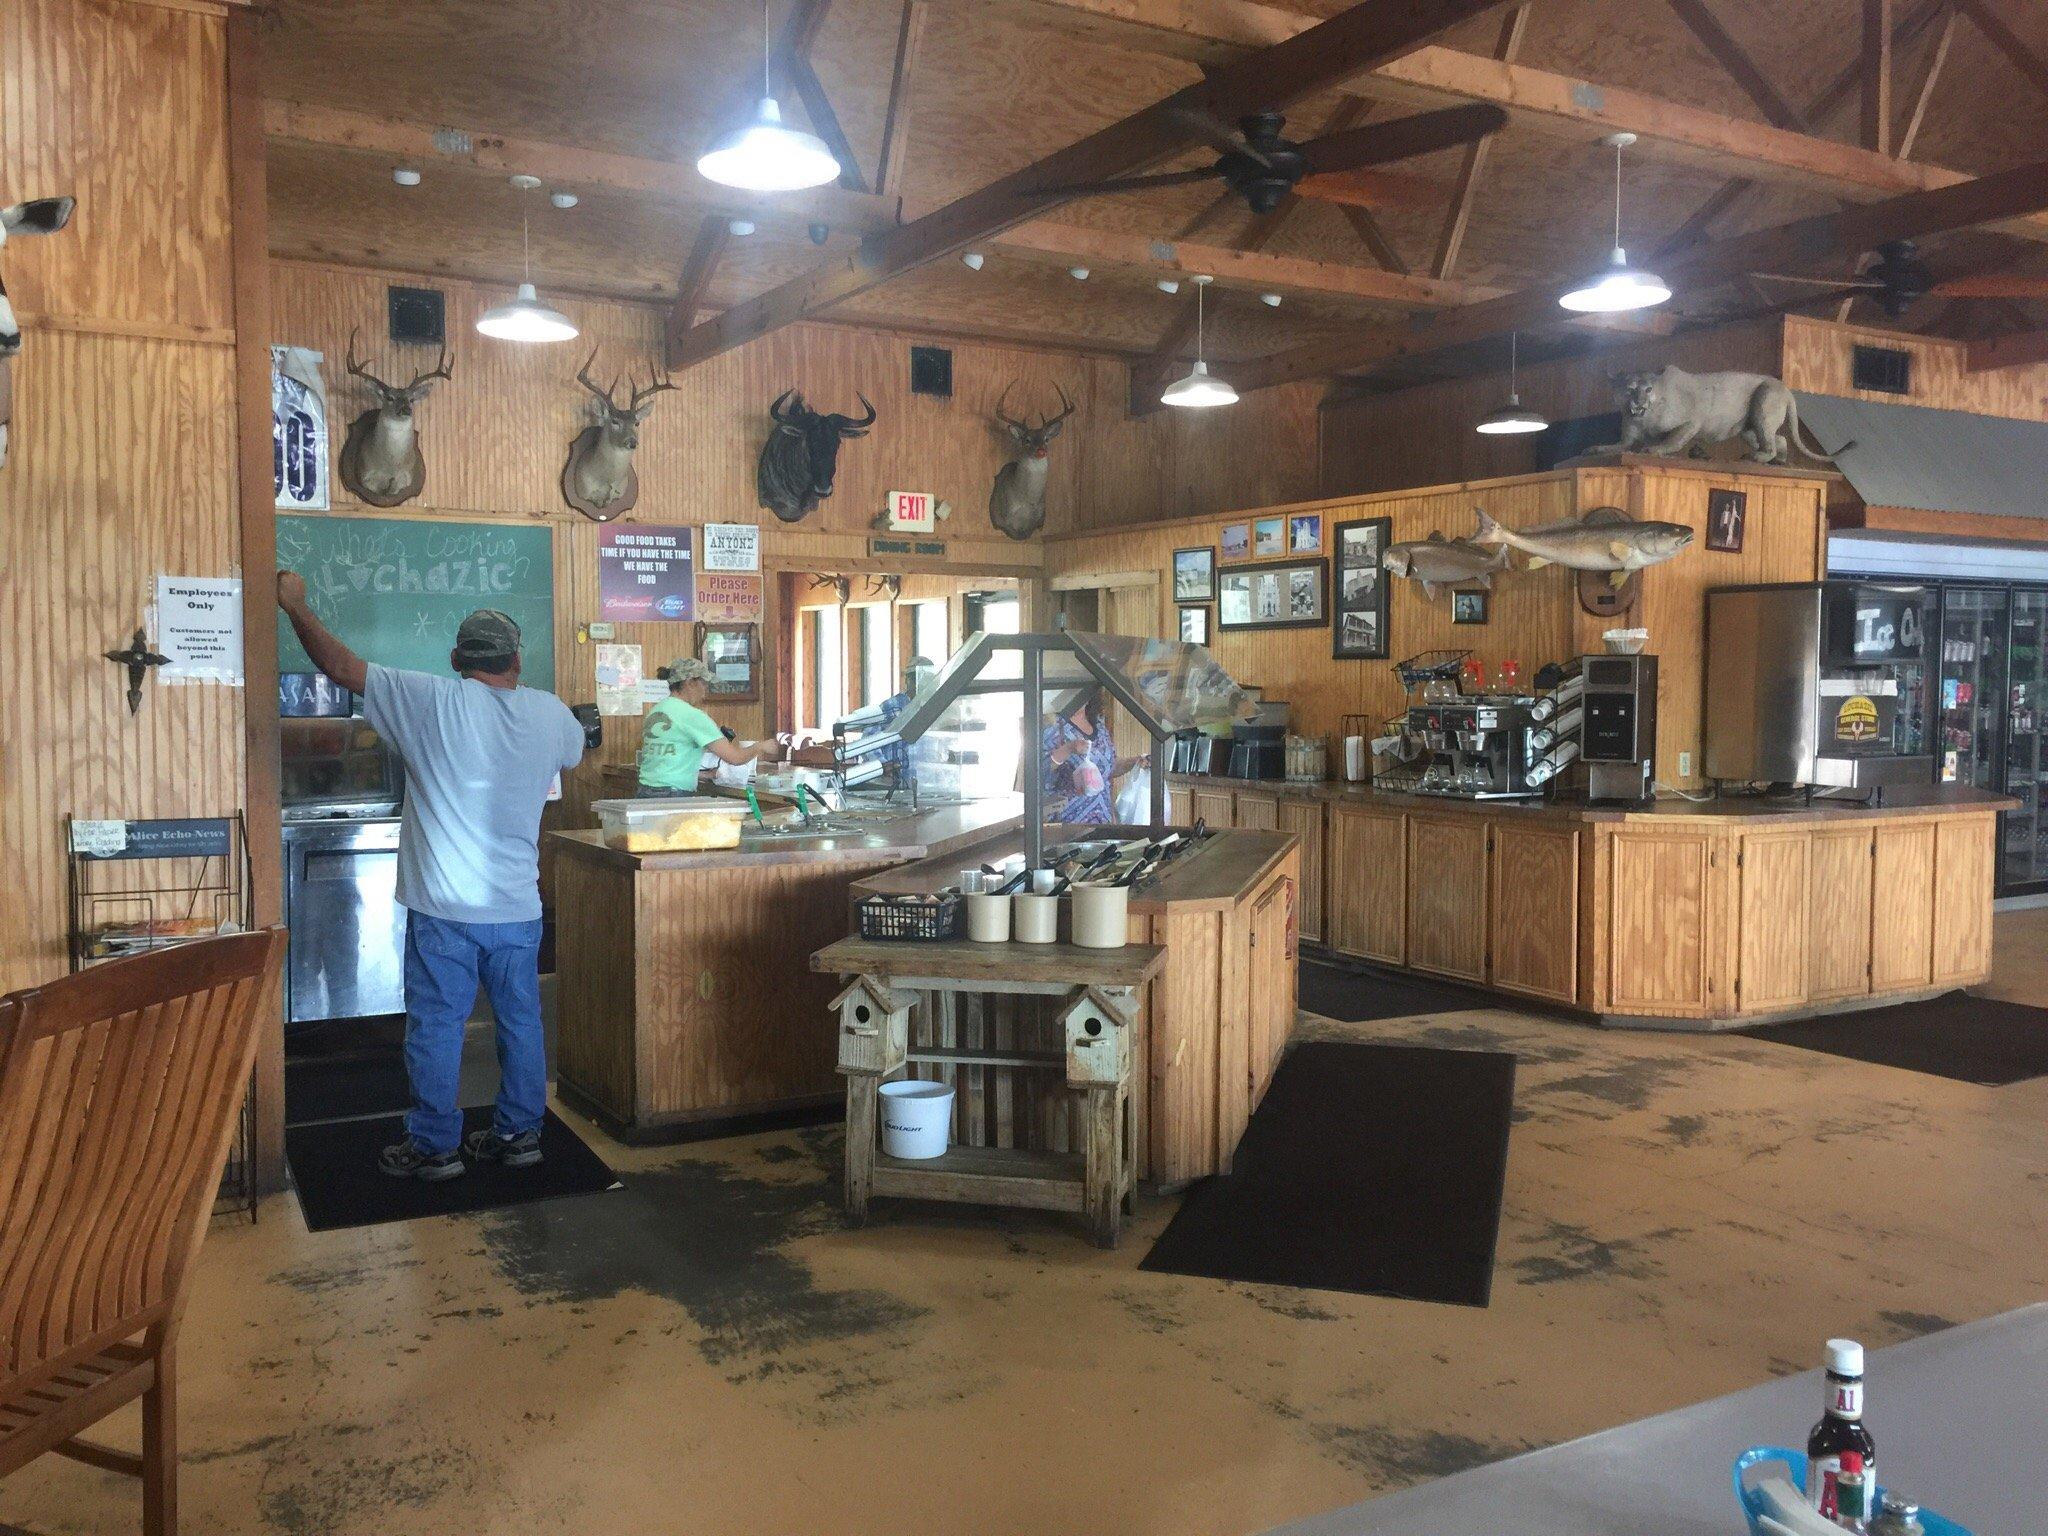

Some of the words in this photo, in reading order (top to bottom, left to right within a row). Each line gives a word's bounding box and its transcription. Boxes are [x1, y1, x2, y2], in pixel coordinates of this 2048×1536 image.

[899, 495, 927, 520] EXIT
[615, 535, 635, 545] GOOD
[636, 535, 654, 545] FOOD
[655, 536, 677, 547] TAKES
[601, 547, 618, 557] TIME
[619, 548, 625, 557] IF
[626, 548, 641, 558] YOU
[642, 549, 659, 559] HAVE
[660, 549, 673, 559] THE
[674, 550, 691, 560] TIME
[623, 561, 635, 571] WE
[636, 561, 654, 571] HAVE
[655, 562, 668, 572] THE
[637, 575, 656, 584] FOOD
[709, 577, 748, 590] Please
[169, 588, 232, 597] Employees
[698, 591, 730, 604] Order
[733, 592, 759, 605] Here
[188, 602, 215, 611] Only
[279, 684, 340, 706] ASANI
[131, 832, 159, 841] Alice
[1818, 1470, 1839, 1521] A
